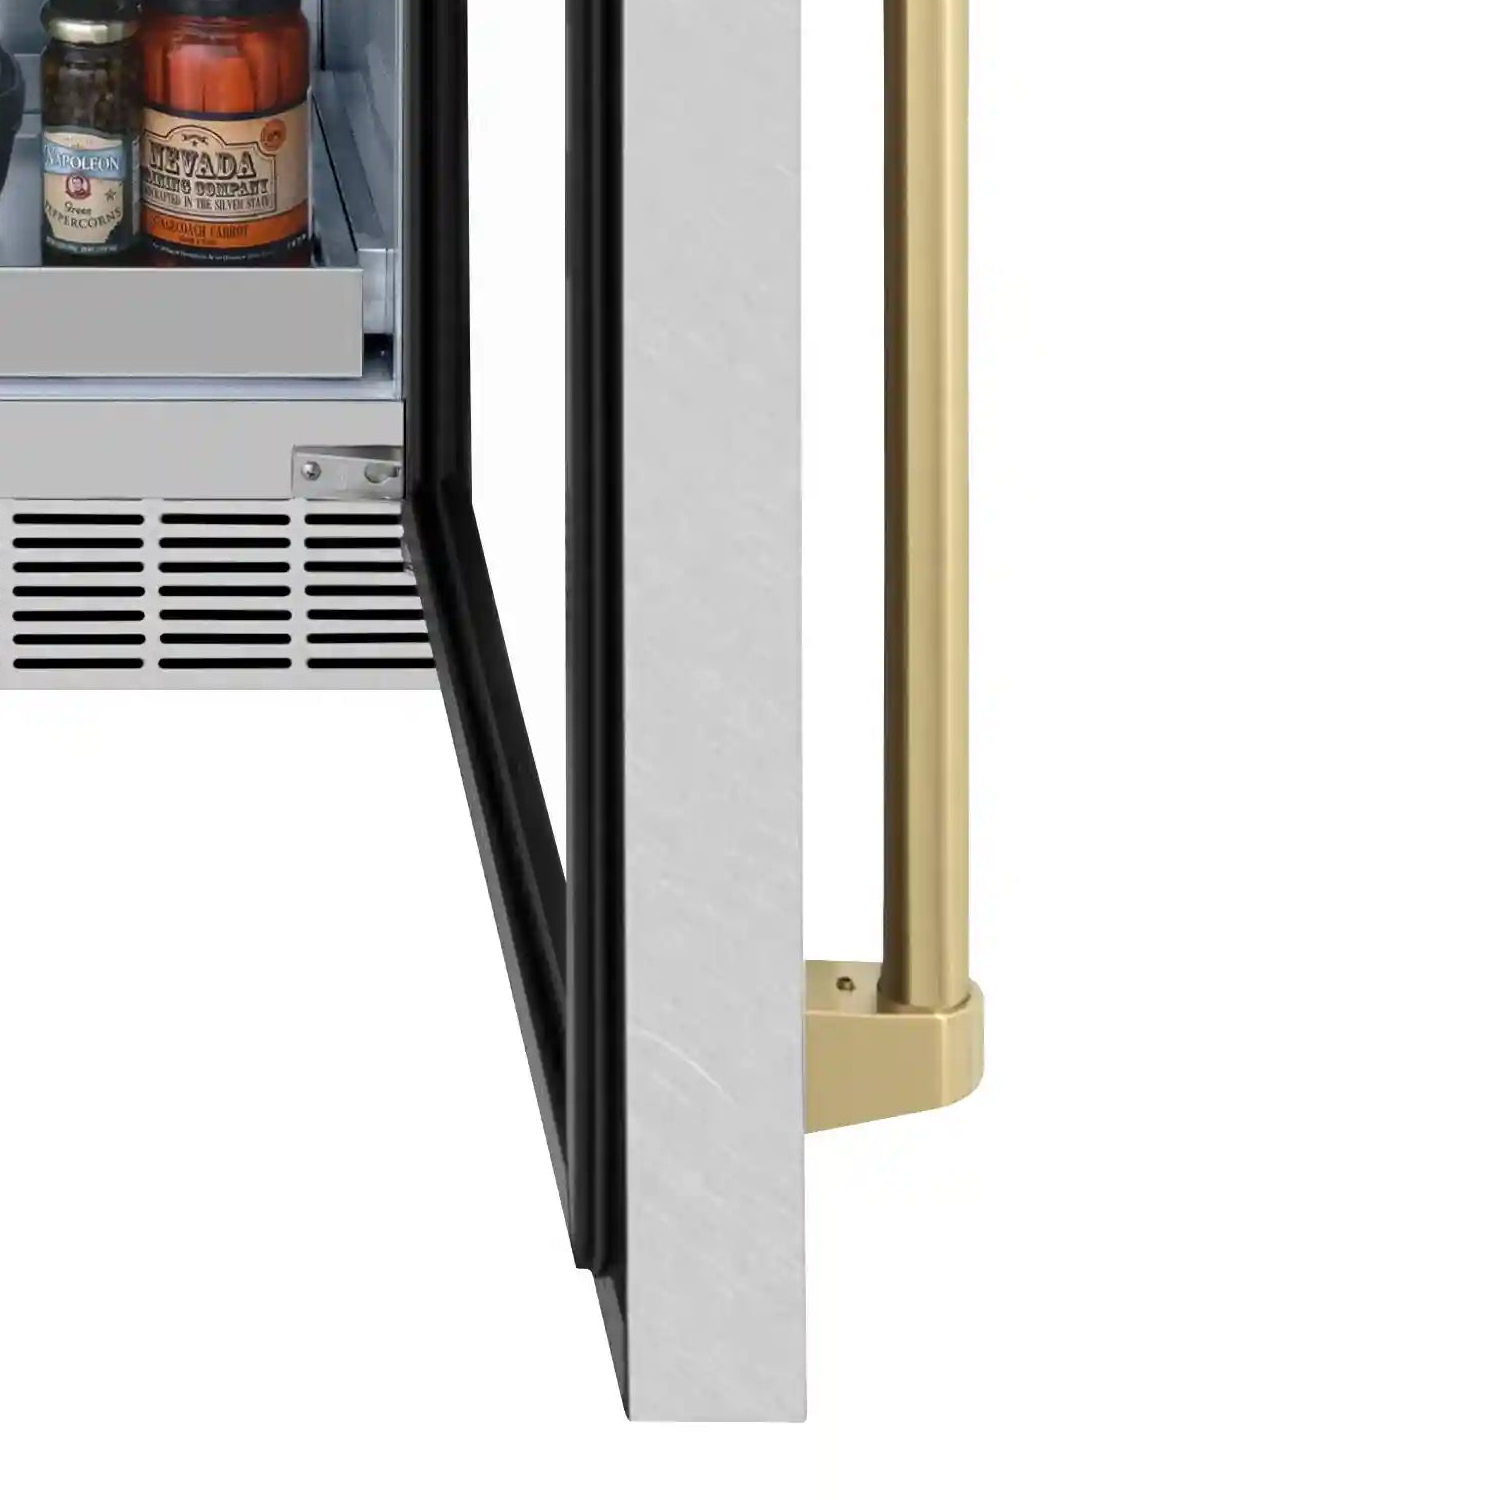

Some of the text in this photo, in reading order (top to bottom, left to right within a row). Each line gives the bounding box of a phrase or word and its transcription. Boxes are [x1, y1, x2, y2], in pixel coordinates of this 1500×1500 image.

[44, 143, 120, 171] NAPOLEON
[149, 141, 257, 180] NEVADA
[194, 178, 269, 198] COMPANY
[65, 201, 92, 216] Green
[184, 195, 193, 208] IN
